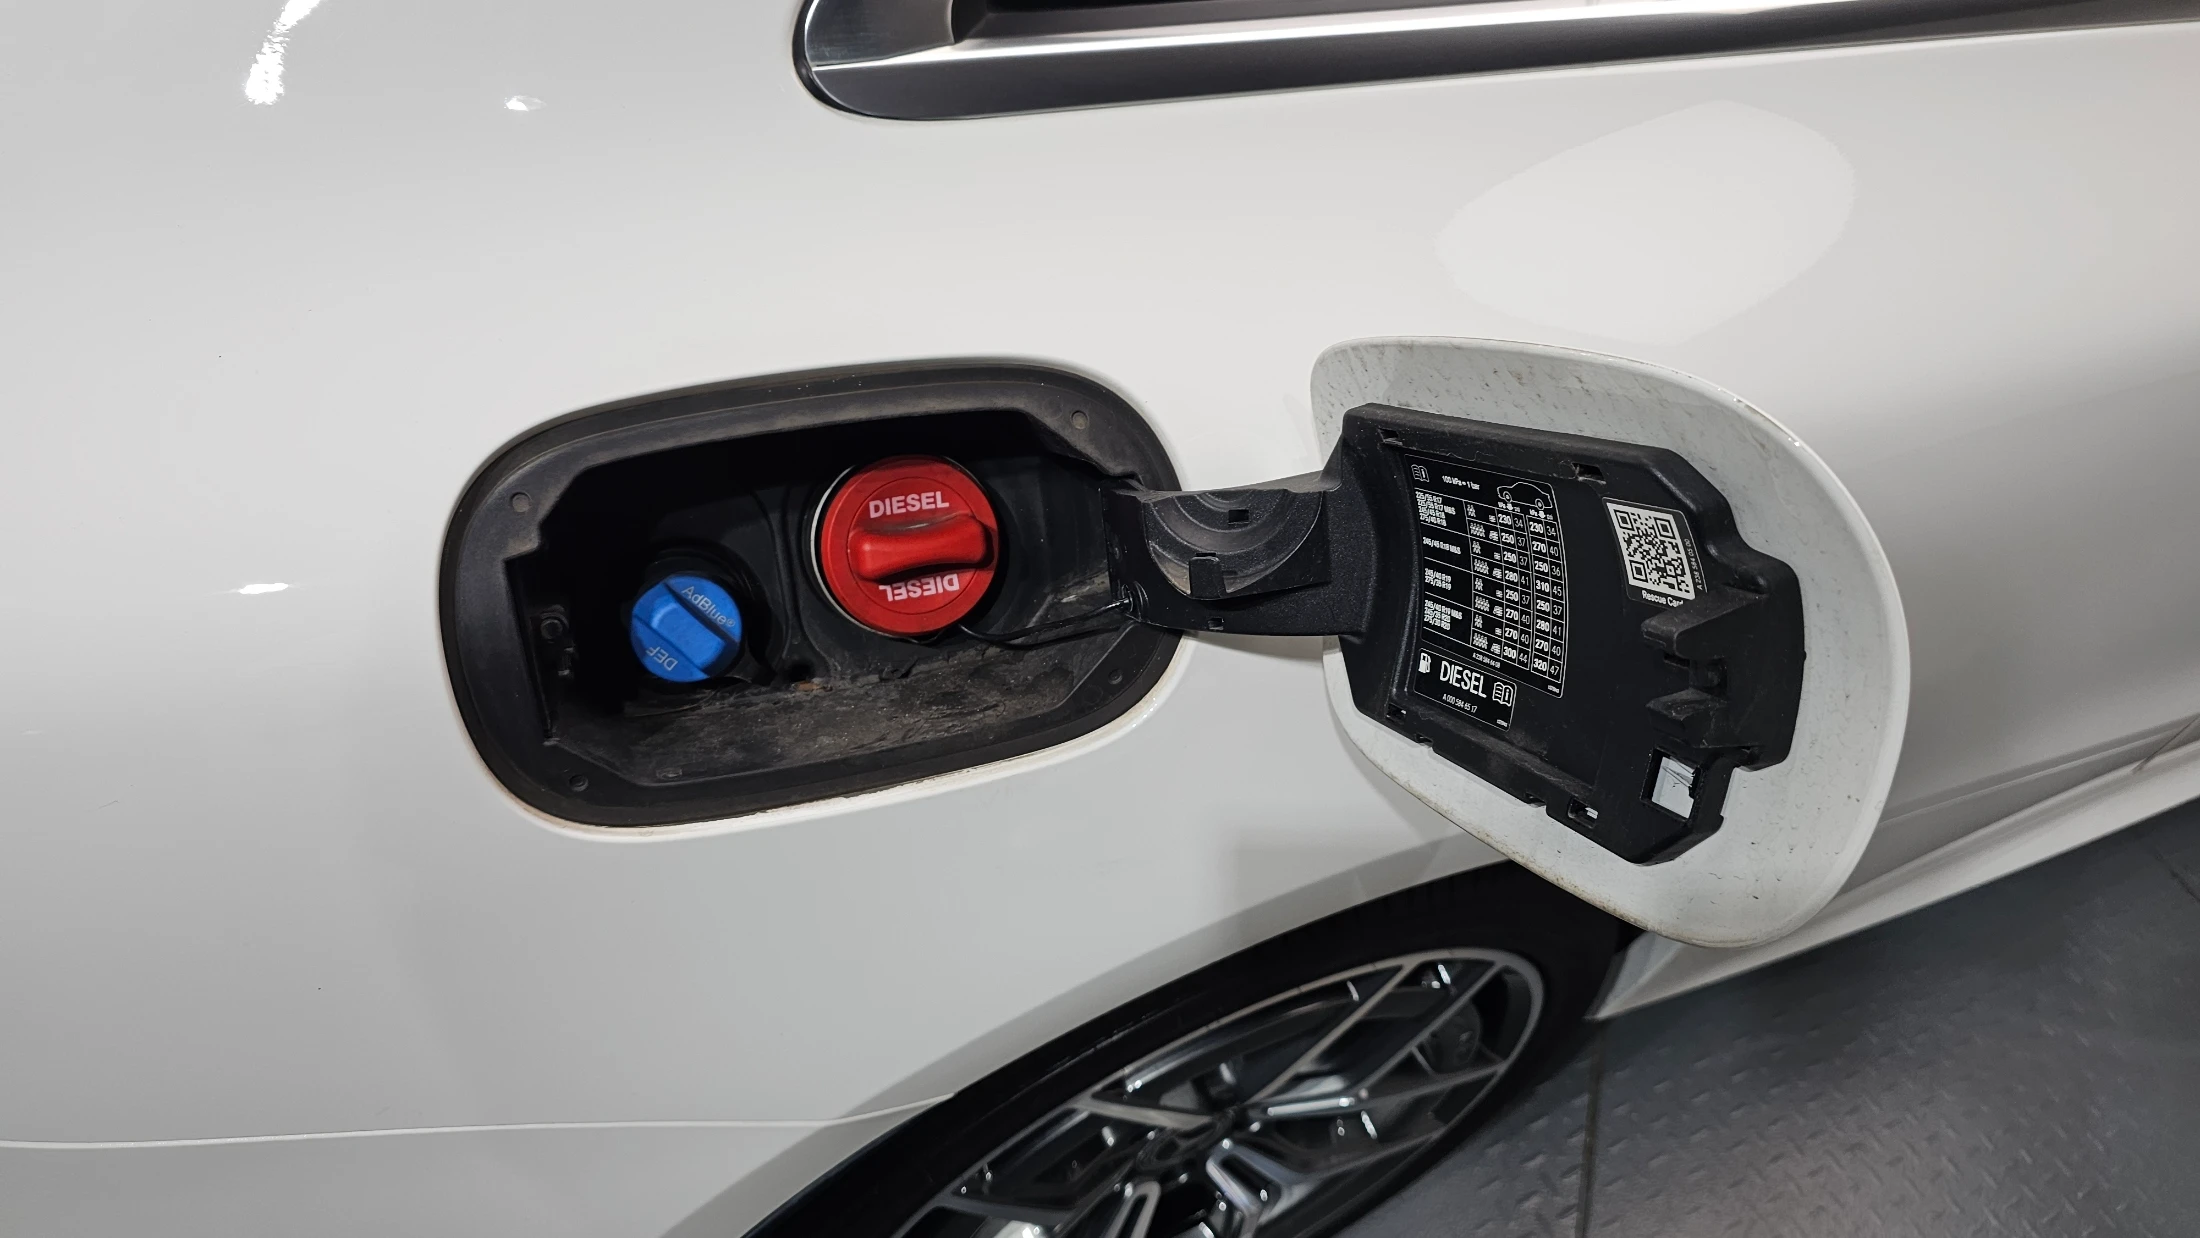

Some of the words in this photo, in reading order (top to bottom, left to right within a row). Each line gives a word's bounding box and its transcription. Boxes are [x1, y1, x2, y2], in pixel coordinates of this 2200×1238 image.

[1442, 476, 1452, 484] 100
[1452, 477, 1462, 486] kPa
[1470, 482, 1480, 490] bar
[869, 490, 950, 518] DIESEL
[1498, 514, 1512, 525] 230
[1514, 518, 1524, 528] 34
[1529, 522, 1544, 534] 230
[1546, 526, 1556, 537] 34
[1501, 532, 1514, 544] 250
[1517, 536, 1526, 546] 37
[1532, 541, 1546, 553] 270
[1550, 546, 1558, 556] 40
[1684, 538, 1692, 547] 00
[1503, 551, 1516, 563] 250
[1520, 556, 1528, 566] 37
[1534, 560, 1548, 572] 250
[1552, 566, 1561, 576] 36
[879, 574, 960, 602] DIESEL
[1505, 570, 1518, 582] 280
[1521, 576, 1529, 586] 41
[1536, 580, 1549, 592] 310
[1552, 586, 1562, 597] 45
[1506, 589, 1518, 601] 250
[1522, 594, 1530, 604] 37
[1536, 600, 1550, 612] 250
[1553, 604, 1562, 616] 37
[1642, 590, 1667, 605] Rescue
[1506, 608, 1518, 620] 270
[1521, 614, 1530, 624] 40
[1536, 619, 1550, 632] 280
[1552, 625, 1562, 637] 41
[1505, 628, 1518, 640] 270
[1520, 634, 1529, 644] 40
[1535, 638, 1548, 652] 270
[1552, 646, 1560, 656] 40
[646, 646, 678, 672] DEF
[1503, 646, 1516, 658] 300
[1518, 653, 1528, 664] 44
[1534, 658, 1547, 672] 320
[1550, 666, 1560, 676] 47
[1440, 660, 1487, 698] DIESEL
[1446, 694, 1456, 704] 000
[1455, 698, 1464, 708] 584
